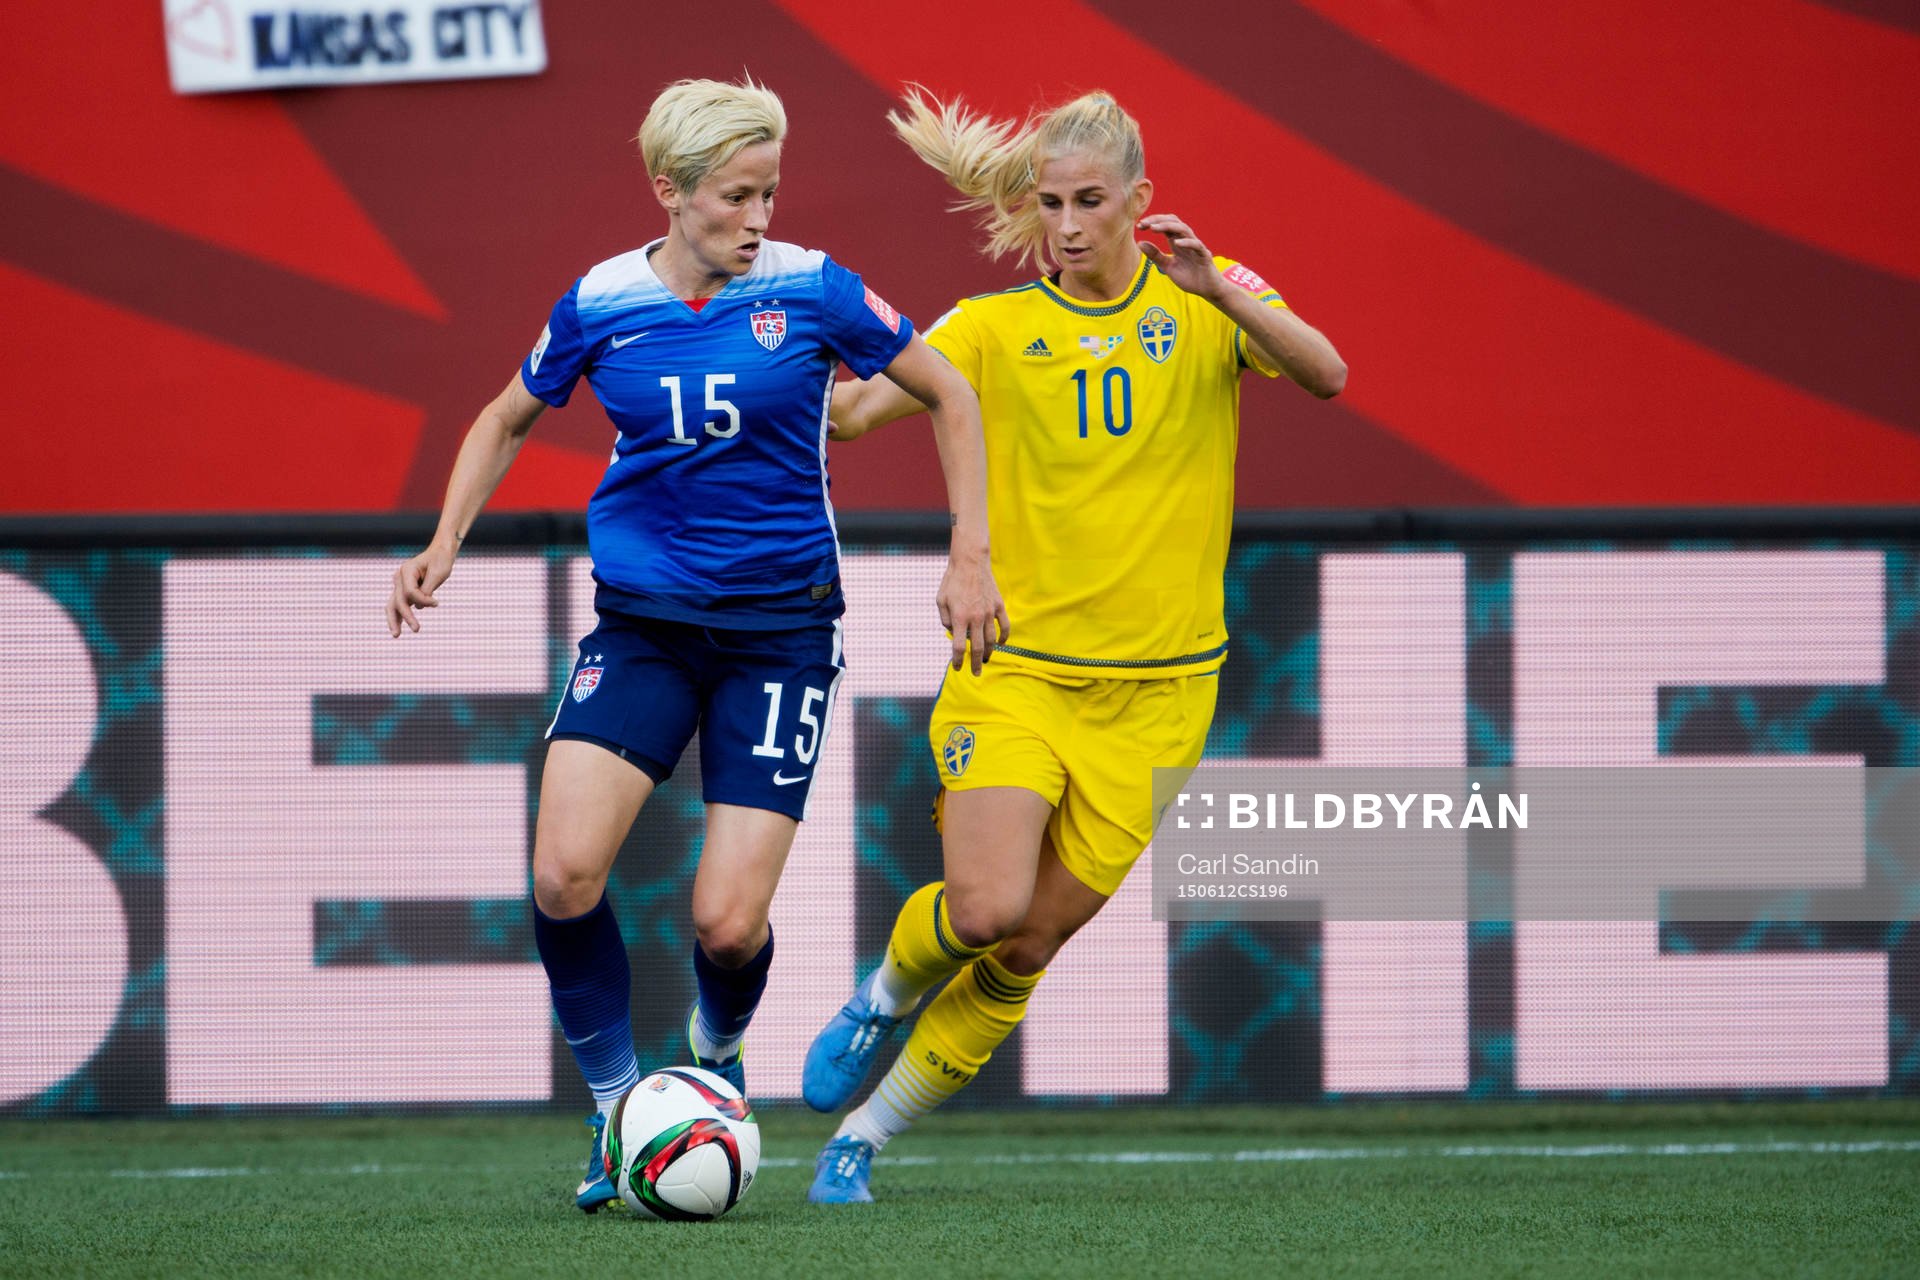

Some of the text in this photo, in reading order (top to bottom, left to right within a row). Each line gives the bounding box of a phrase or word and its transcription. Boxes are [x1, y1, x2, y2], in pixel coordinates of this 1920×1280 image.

[250, 4, 526, 70] KANSAS CITY
[1023, 349, 1053, 357] adidas
[660, 373, 741, 446] 15
[1070, 366, 1132, 438] 10
[752, 682, 825, 764] 15
